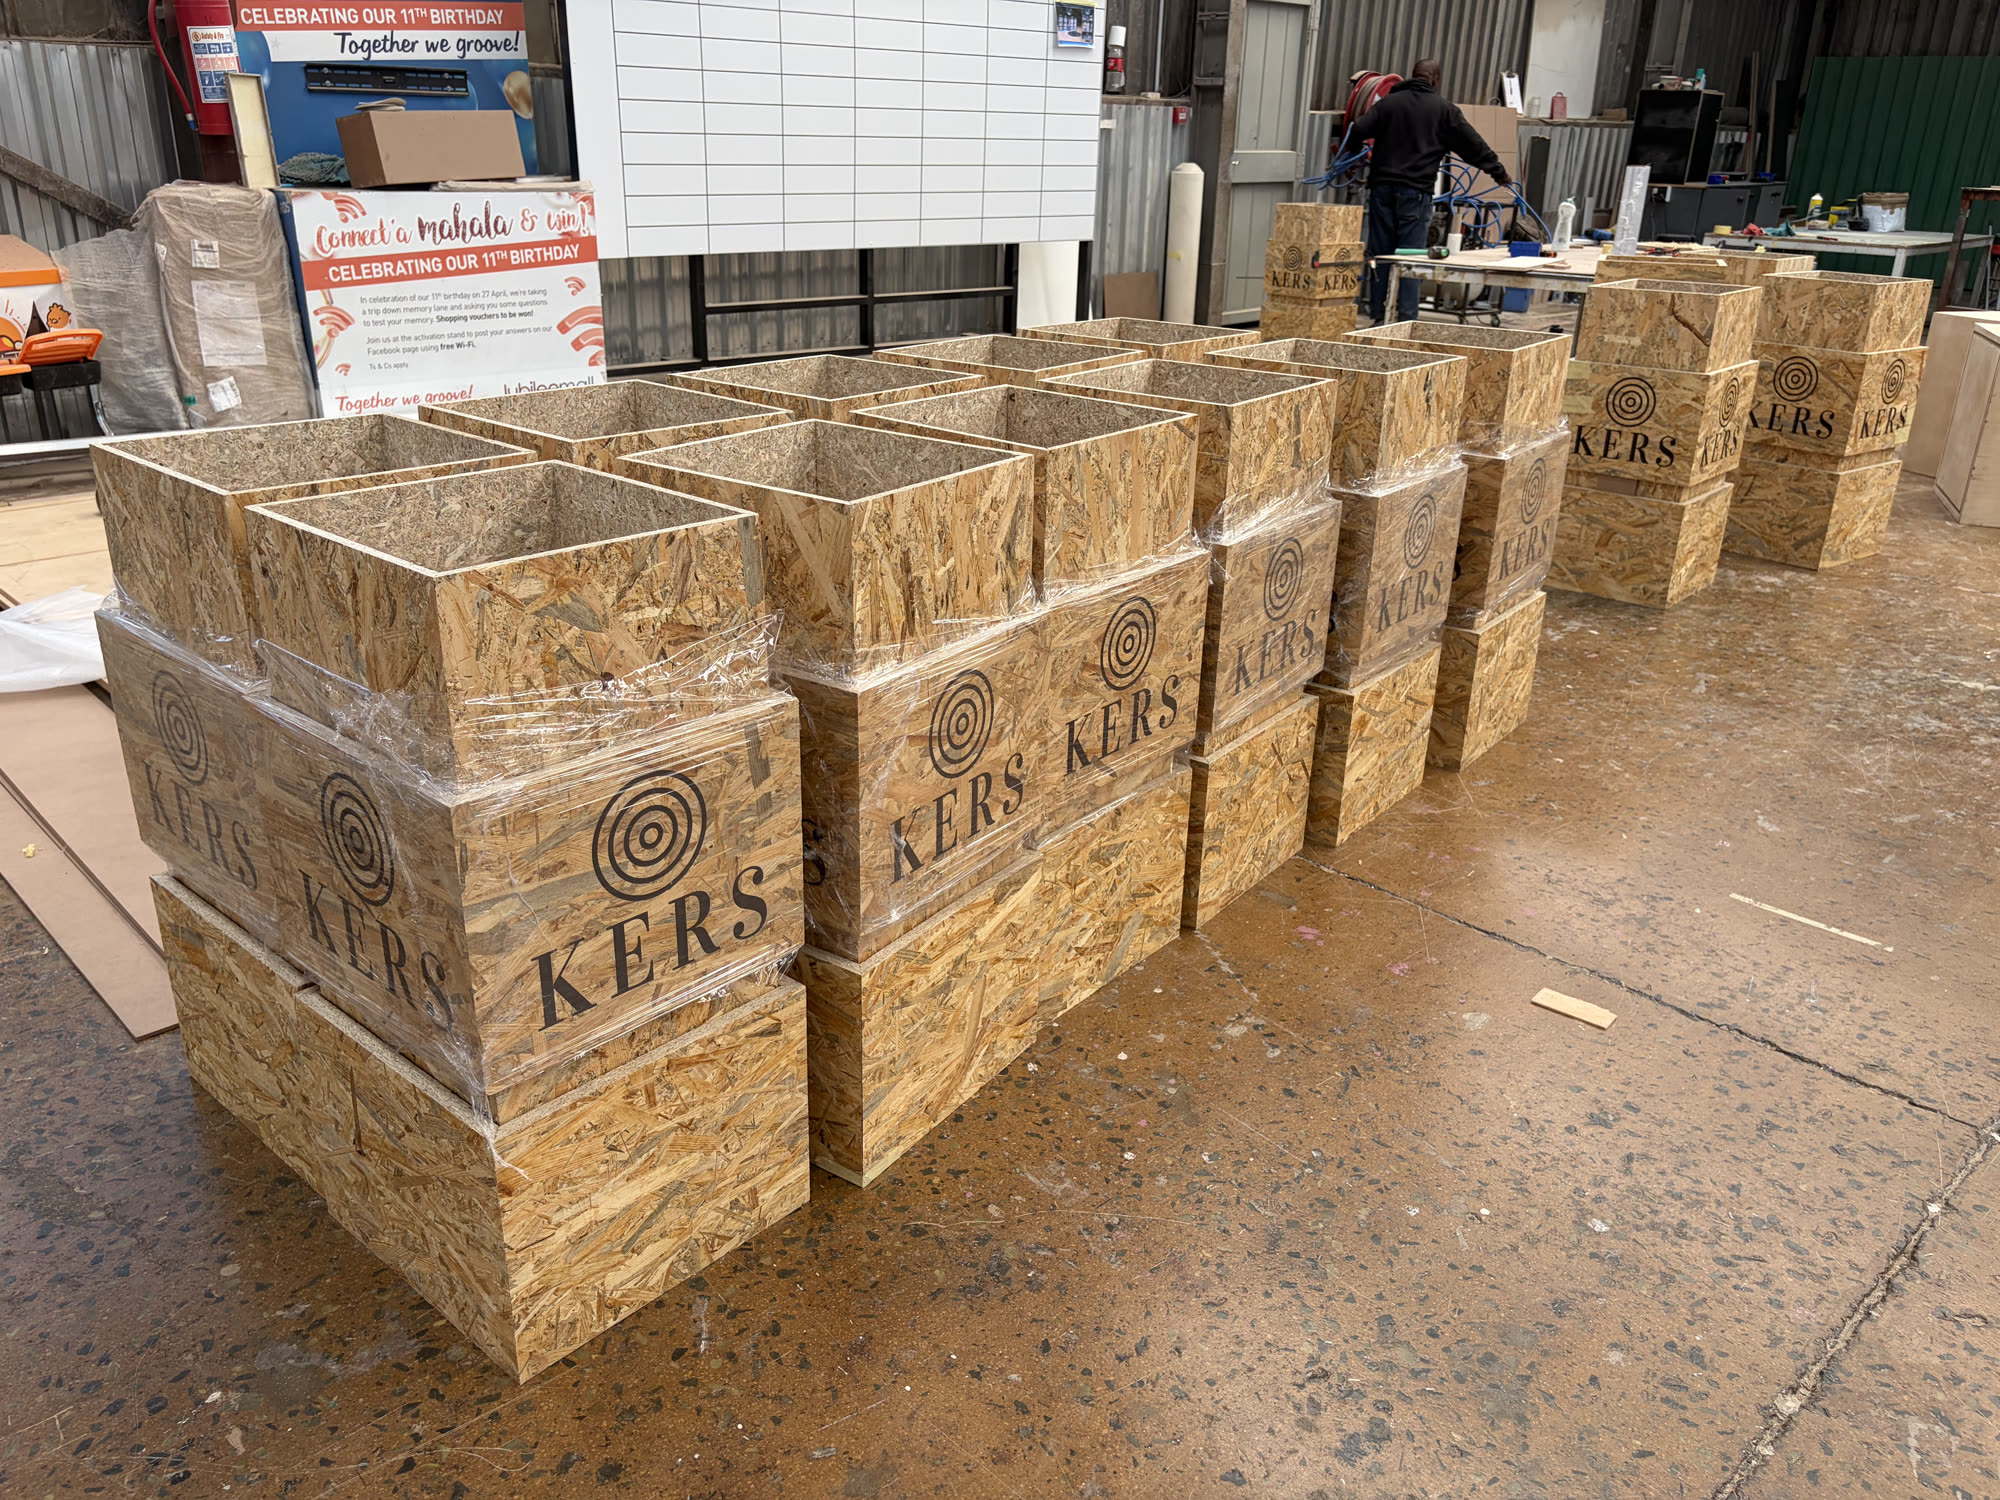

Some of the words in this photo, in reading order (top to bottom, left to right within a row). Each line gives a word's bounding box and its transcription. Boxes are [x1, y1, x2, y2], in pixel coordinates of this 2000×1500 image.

[240, 8, 359, 24] CELEBRATING
[362, 8, 397, 24] OUR
[430, 9, 504, 24] BIRTHDAY
[333, 30, 418, 60] Together
[425, 40, 451, 52] we
[456, 30, 520, 59] groove!
[418, 201, 513, 246] mahala
[521, 208, 537, 232] &
[547, 203, 587, 235] win!
[328, 257, 442, 282] CELEBRATING
[445, 254, 478, 271] OUR
[510, 243, 579, 265] BIRTHDAY
[1272, 271, 1311, 290] KERS
[369, 294, 408, 303] celebration
[410, 294, 416, 302] of
[443, 292, 471, 300] birthday
[528, 288, 548, 296] taking
[1324, 273, 1358, 291] KERS
[368, 307, 380, 316] trip
[382, 306, 402, 315] down
[464, 302, 486, 311] asking
[518, 300, 548, 308] questions
[387, 318, 402, 327] your
[404, 317, 434, 326] memory.
[436, 314, 468, 323] Shopping
[469, 312, 500, 320] vouchers
[518, 310, 534, 318] won!
[366, 336, 380, 344] Join
[414, 333, 446, 341] activation
[474, 330, 488, 338] post
[368, 346, 400, 356] Facebook
[402, 346, 420, 354] page
[420, 344, 439, 352] using
[394, 362, 408, 370] apply
[335, 392, 398, 414] Together
[402, 394, 420, 406] we
[1860, 405, 1908, 439] KERS
[1573, 425, 1676, 468] KERS
[1701, 425, 1740, 467] KERS
[1499, 519, 1550, 581] KERS
[1376, 560, 1444, 633] KERS
[1234, 609, 1318, 696] KERS
[1064, 674, 1180, 777] KERS
[142, 760, 258, 891] KERS
[890, 752, 1024, 884] KERS
[298, 868, 454, 1030] KERS
[532, 865, 767, 1032] KERS
